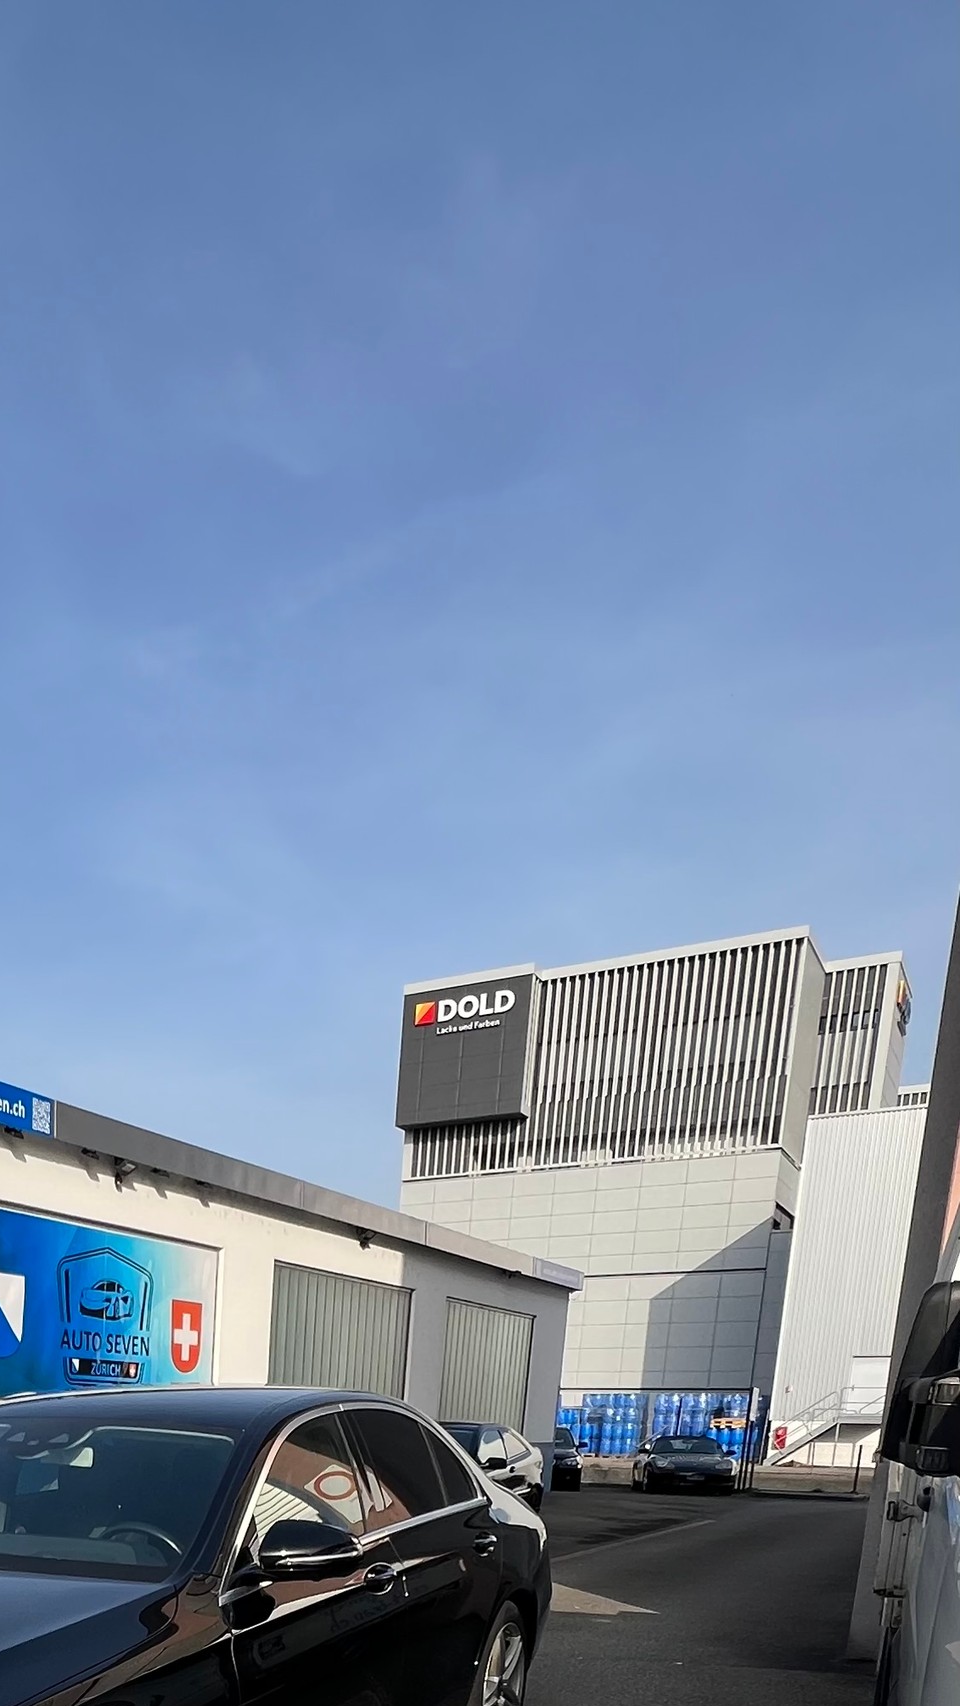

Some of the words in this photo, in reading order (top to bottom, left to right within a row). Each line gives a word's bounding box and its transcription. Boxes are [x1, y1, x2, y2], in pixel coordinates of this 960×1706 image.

[437, 990, 516, 1023] DOLD
[458, 1022, 473, 1031] und
[474, 1019, 500, 1030] Farben
[60, 1328, 103, 1351] AUTO
[105, 1333, 150, 1357] SEVEN
[90, 1360, 122, 1377] ZÜRICH
